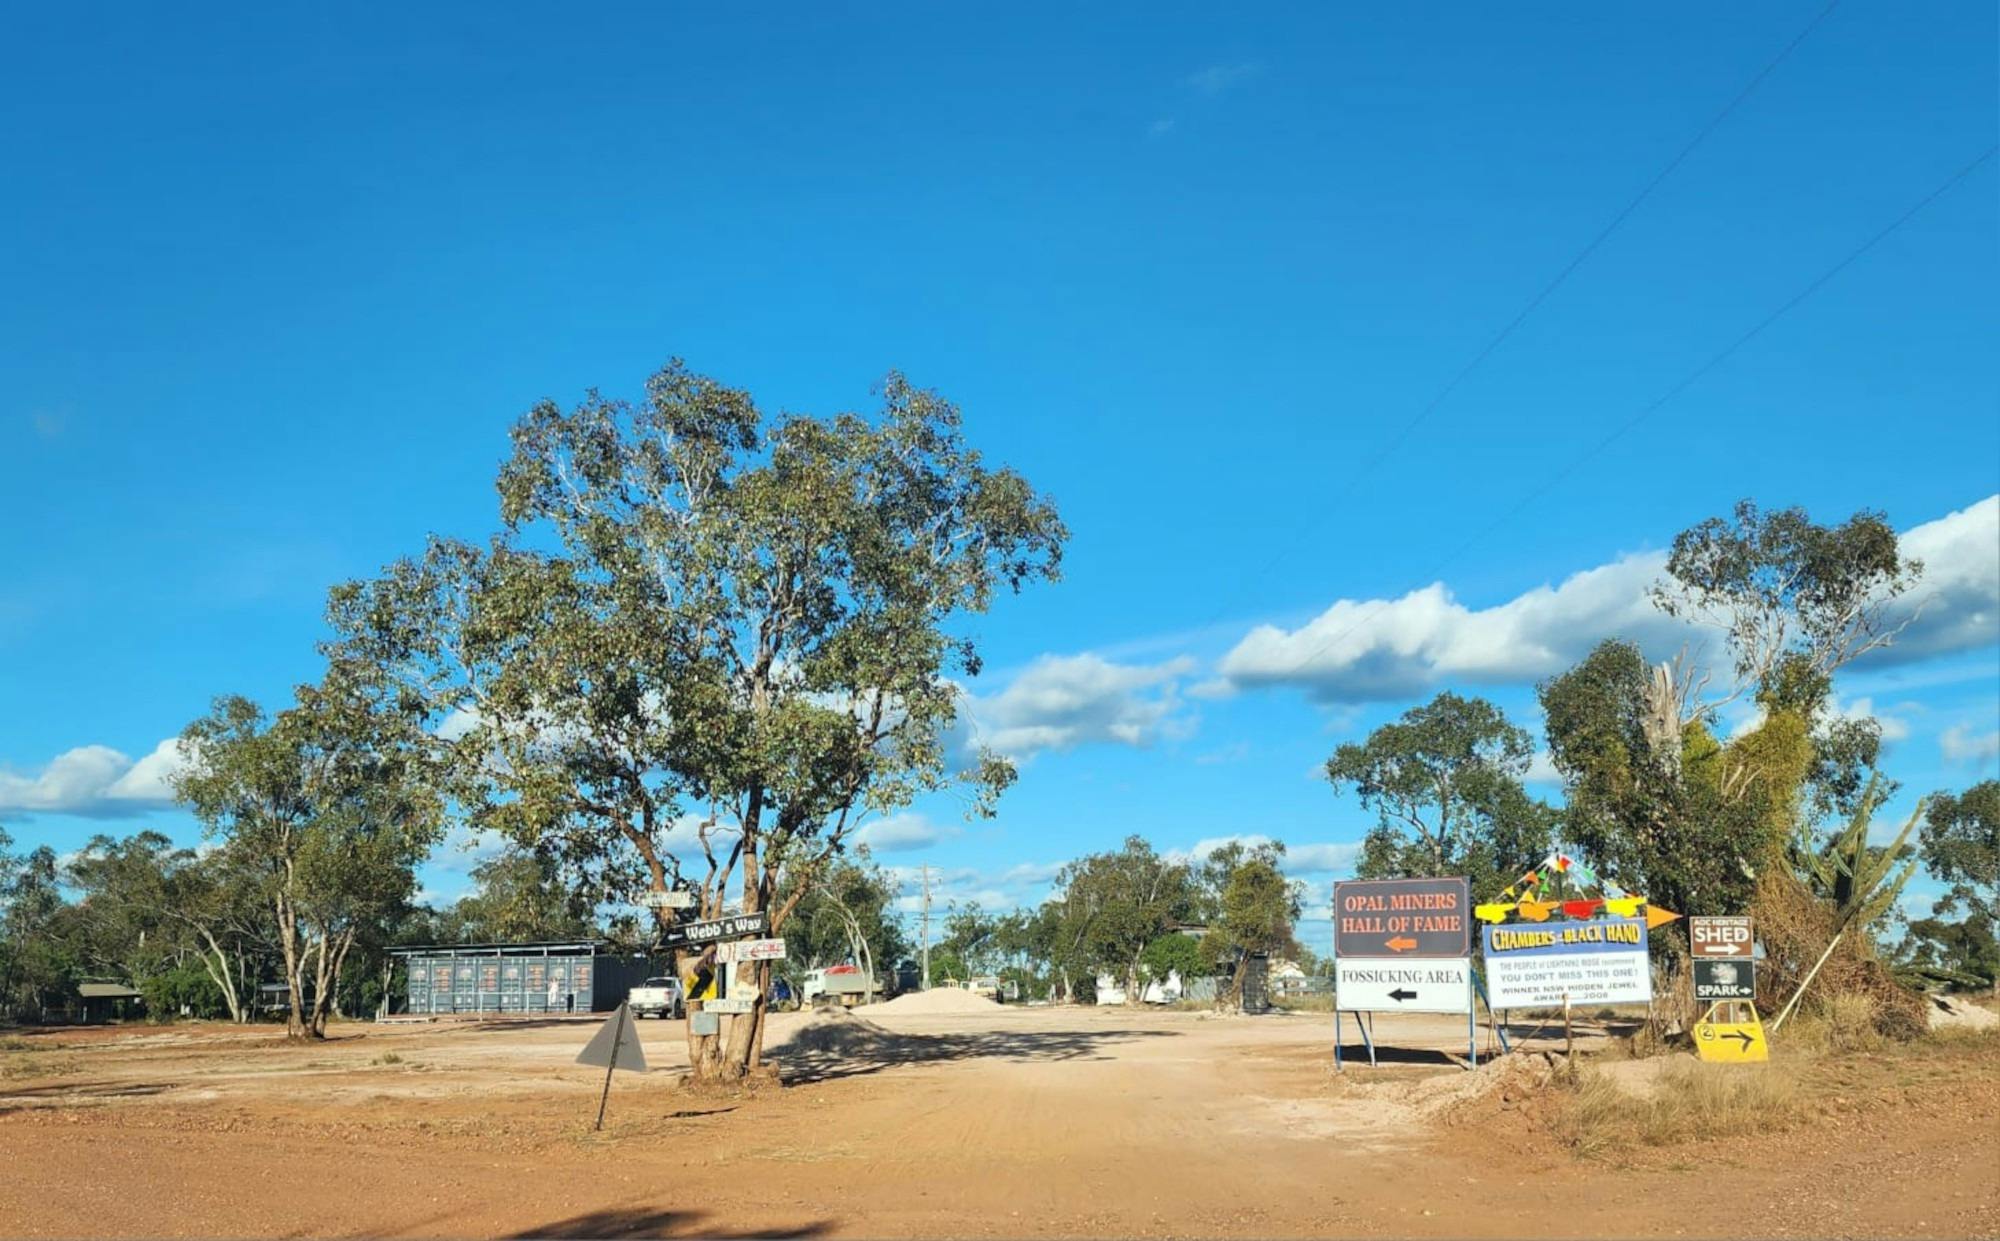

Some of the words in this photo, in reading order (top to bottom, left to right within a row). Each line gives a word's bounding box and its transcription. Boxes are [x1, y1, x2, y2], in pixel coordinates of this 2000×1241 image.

[1345, 895, 1387, 912] OPAL
[1390, 893, 1457, 911] MINERS
[685, 921, 734, 940] Webb's
[735, 918, 761, 932] Way
[1342, 917, 1385, 933] HALL
[1387, 916, 1410, 932] OF
[1413, 915, 1461, 932] FAME
[1491, 928, 1556, 951] CHAMBERS
[1562, 925, 1602, 944] BLACK
[1605, 923, 1641, 944] HAND
[1694, 927, 1749, 943] SHED
[1514, 961, 1537, 970] PEOPLE
[1342, 970, 1422, 984] FOSSICKING
[1426, 970, 1464, 984] AREA
[1501, 973, 1521, 982] YOU
[1525, 971, 1554, 981] DON'T
[1558, 970, 1582, 980] MISS
[1587, 969, 1609, 978] THIS
[1501, 985, 1541, 995] WINNER
[1543, 984, 1565, 993] NSW
[1568, 983, 1604, 992] HIDDEN
[1607, 981, 1638, 989] JEWEL
[1697, 985, 1740, 997] SPARK
[1533, 993, 1568, 1001] AWAR
